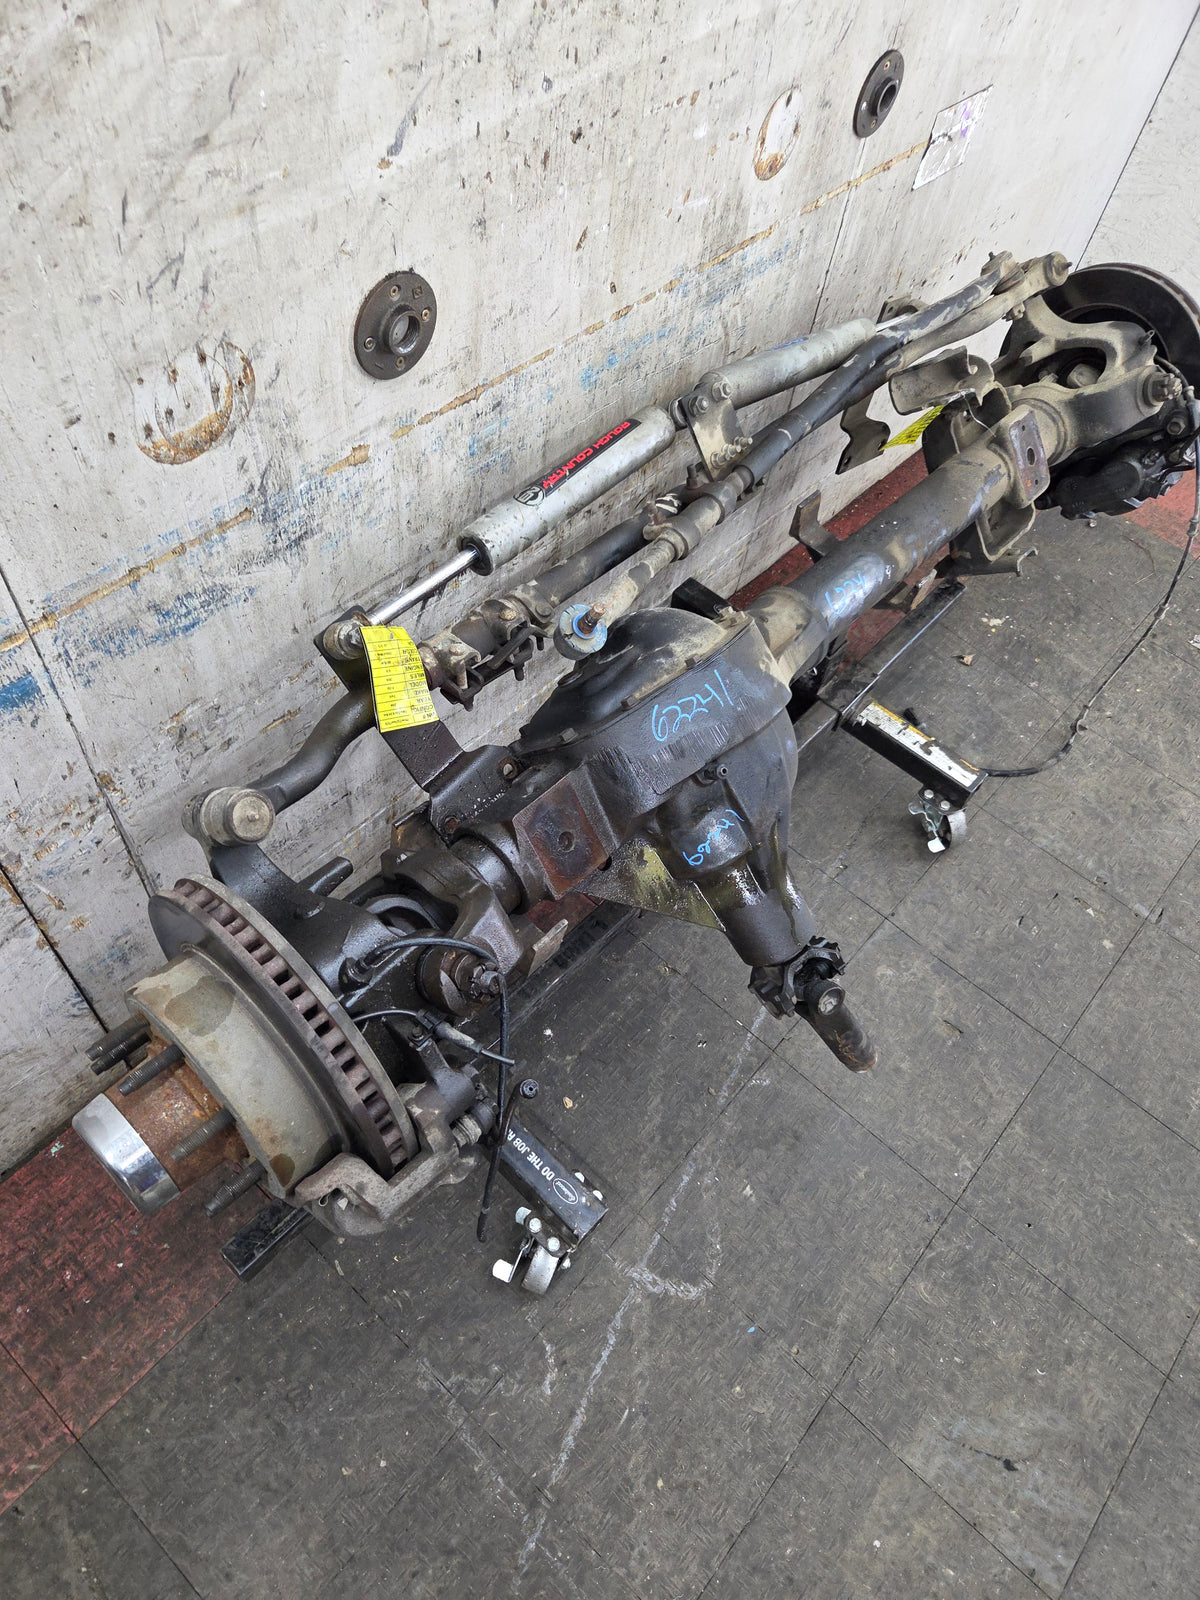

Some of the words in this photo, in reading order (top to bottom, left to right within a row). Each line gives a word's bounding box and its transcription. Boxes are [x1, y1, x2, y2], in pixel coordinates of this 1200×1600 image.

[593, 421, 631, 449] ROUGH
[542, 447, 594, 489] COUNTRY
[651, 669, 734, 741] 62241
[683, 809, 744, 866] 62241
[513, 1137, 530, 1154] JOB
[526, 1152, 544, 1170] THE
[541, 1166, 555, 1181] DO
